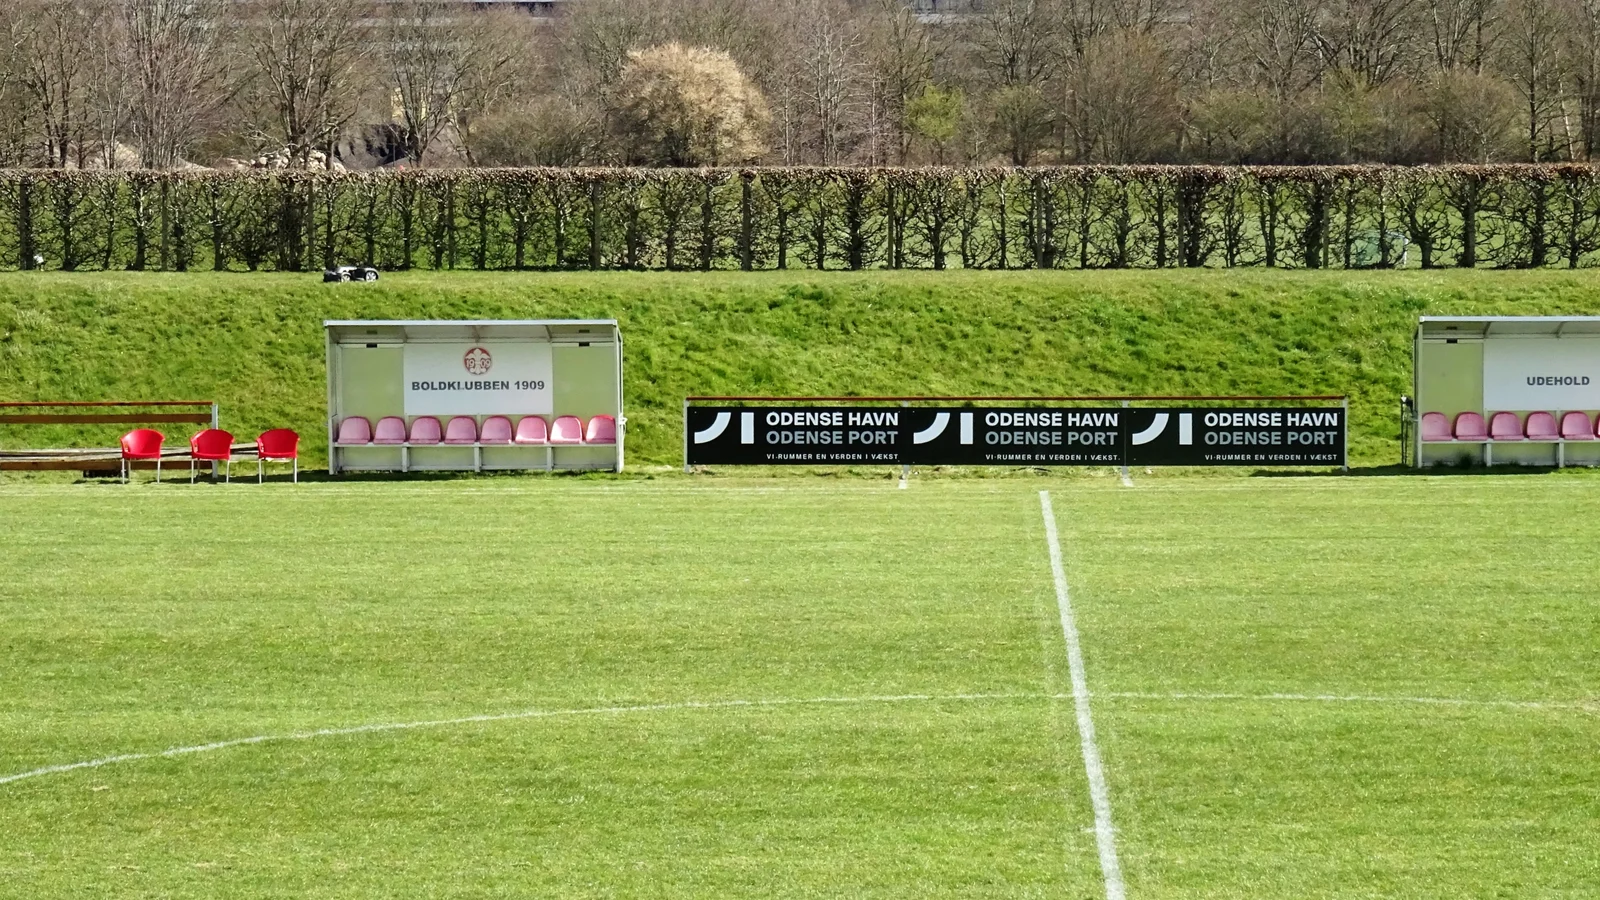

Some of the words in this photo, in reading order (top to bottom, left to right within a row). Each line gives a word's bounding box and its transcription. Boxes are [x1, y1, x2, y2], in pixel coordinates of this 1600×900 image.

[411, 381, 510, 391] BOLDKLUBBEN
[514, 380, 545, 390] 1909
[1526, 376, 1590, 386] UDEHOLD
[766, 412, 843, 426] ODENSE
[848, 412, 899, 426] HAVN
[985, 412, 1062, 427] ODENSE
[1067, 412, 1119, 427] HAVN
[1204, 412, 1282, 427] ODENSE
[1287, 412, 1338, 427] HAVN
[766, 430, 843, 445] ODENSE
[848, 430, 899, 445] PORT
[985, 431, 1062, 446] ODENSE
[1067, 431, 1119, 446] PORT
[1204, 431, 1282, 446] ODENSE
[1287, 431, 1338, 446] PORT
